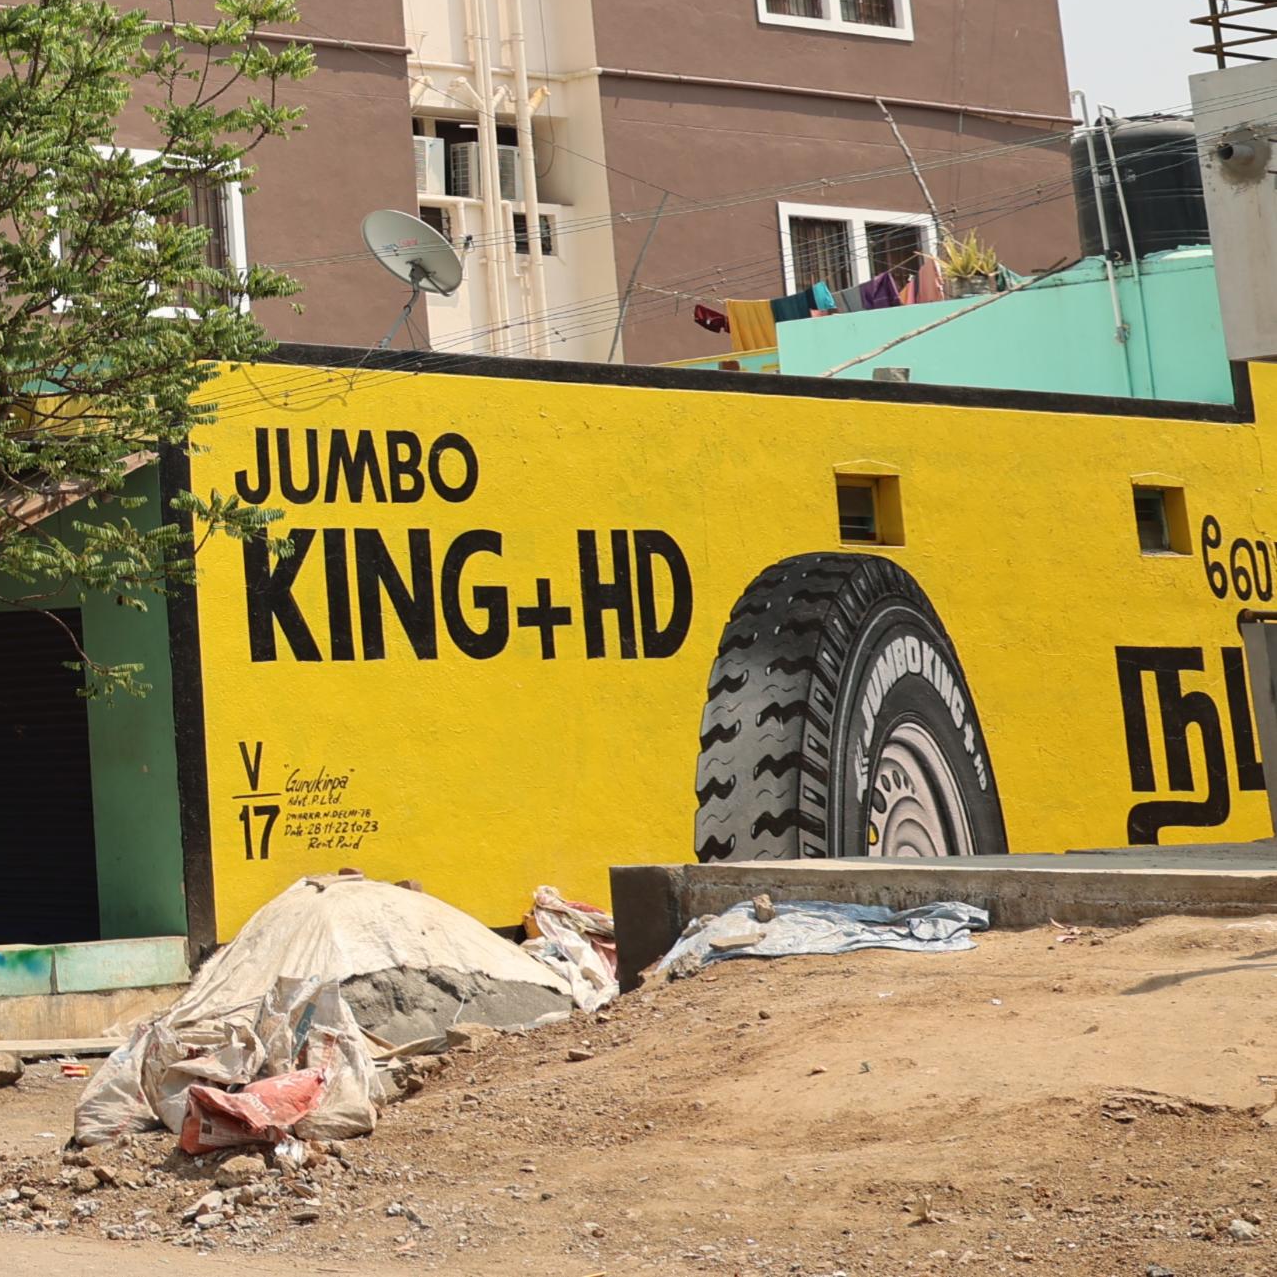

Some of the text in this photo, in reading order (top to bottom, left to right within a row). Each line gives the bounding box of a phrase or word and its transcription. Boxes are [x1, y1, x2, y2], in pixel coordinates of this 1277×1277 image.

[235, 427, 479, 505] JUMBO
[242, 528, 693, 662] KING+HD
[861, 636, 922, 749] JUMBO
[238, 741, 263, 791] V
[239, 805, 281, 860] 17
[308, 836, 363, 850] Rent Paid
